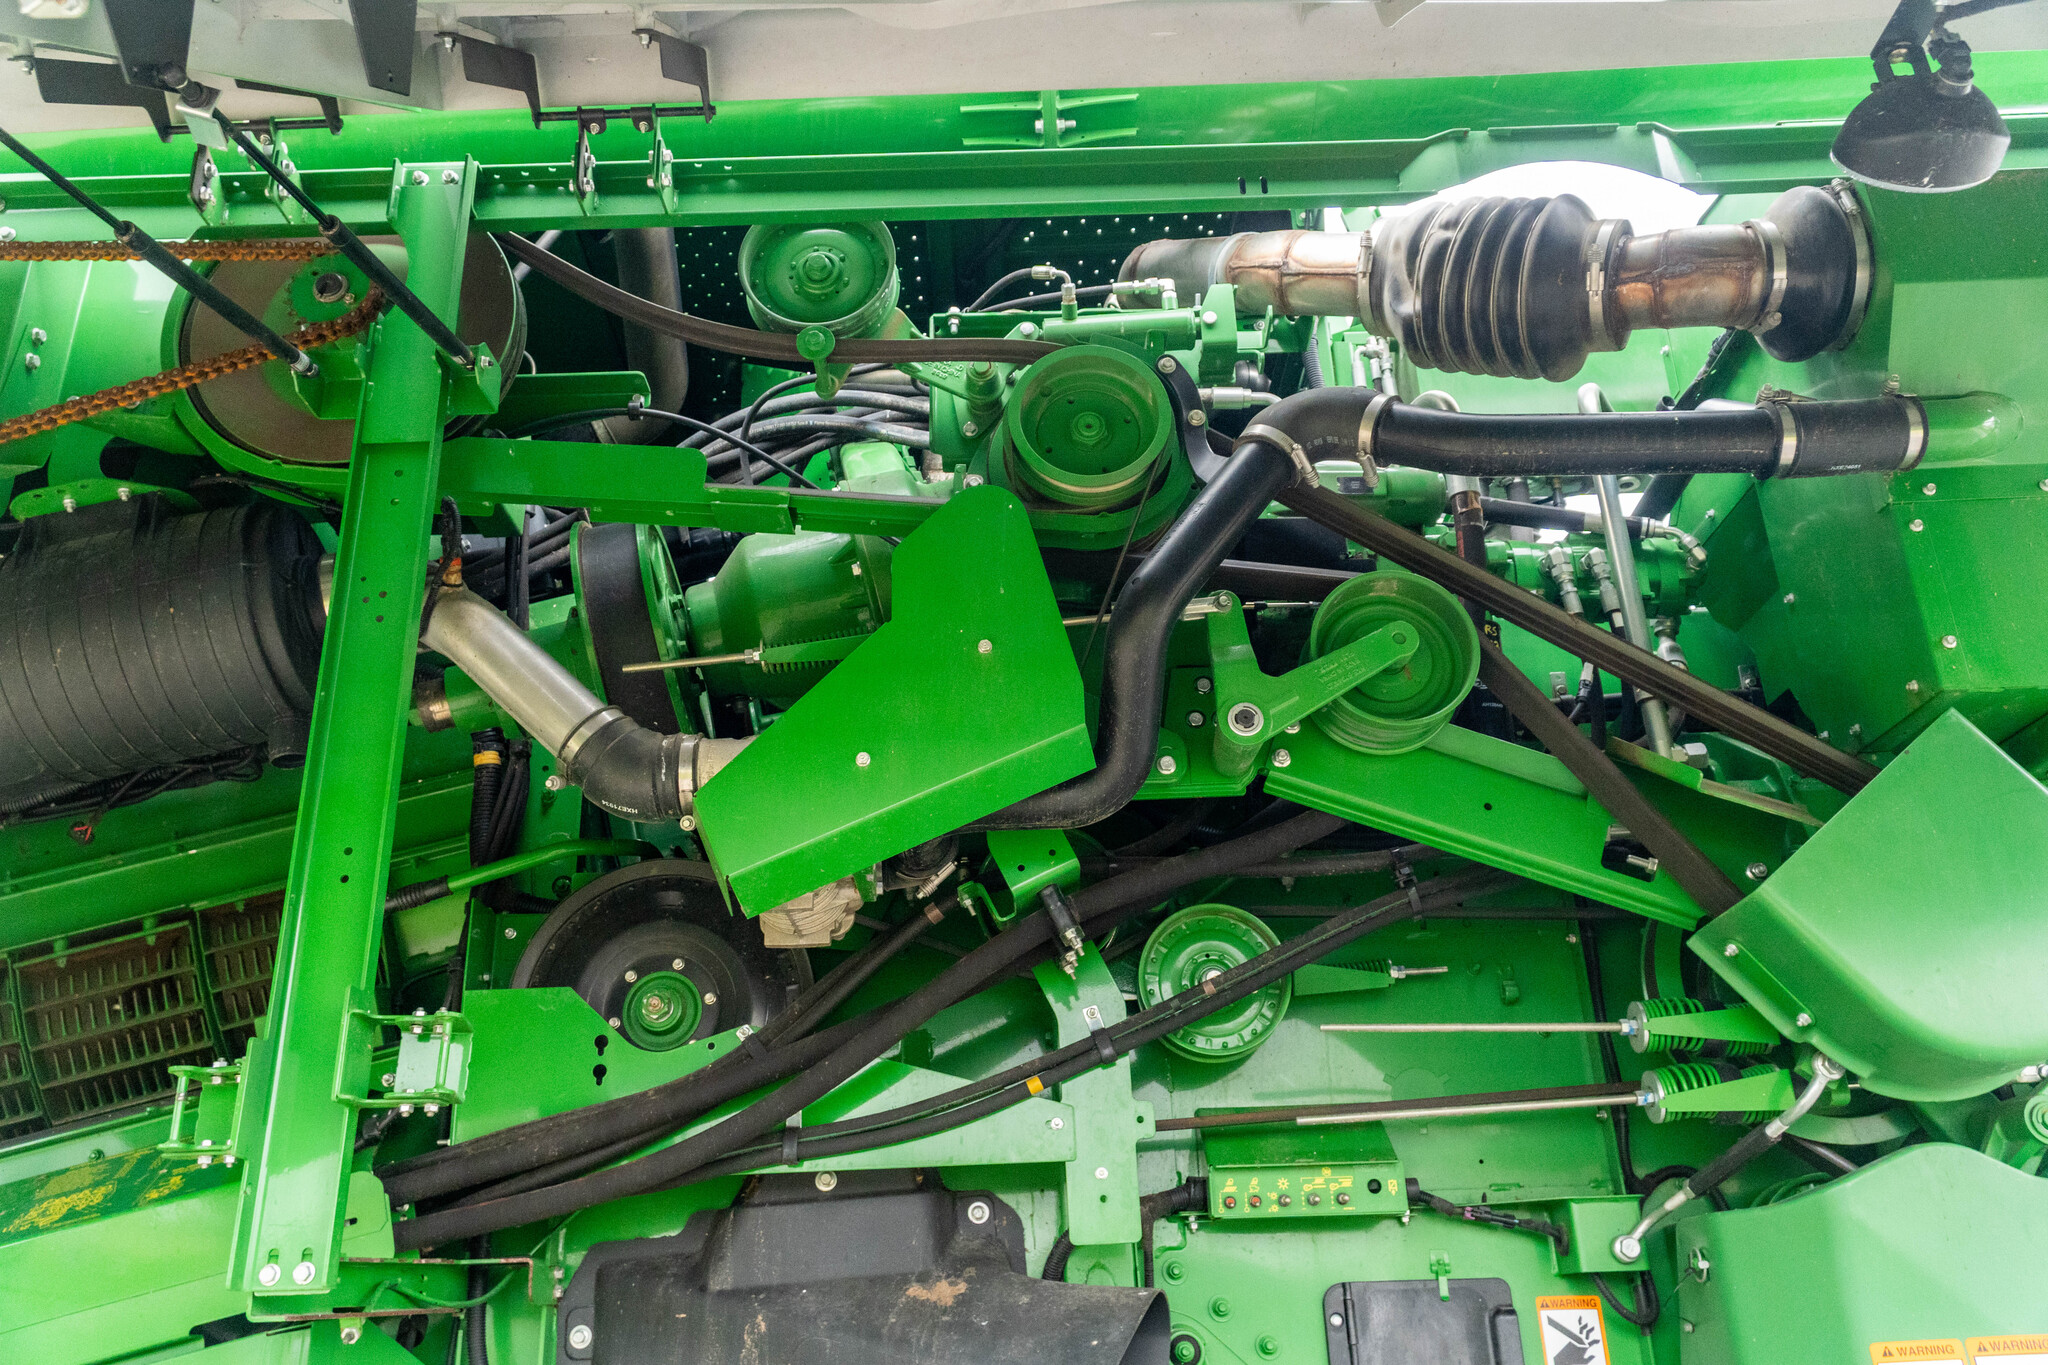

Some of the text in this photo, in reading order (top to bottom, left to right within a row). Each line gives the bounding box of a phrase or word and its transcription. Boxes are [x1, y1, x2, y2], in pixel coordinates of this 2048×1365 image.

[602, 799, 638, 814] HXE71934
[1550, 1298, 1597, 1308] WARNING
[1896, 1344, 1955, 1357] WARNING
[1989, 1338, 2048, 1352] WARNING
